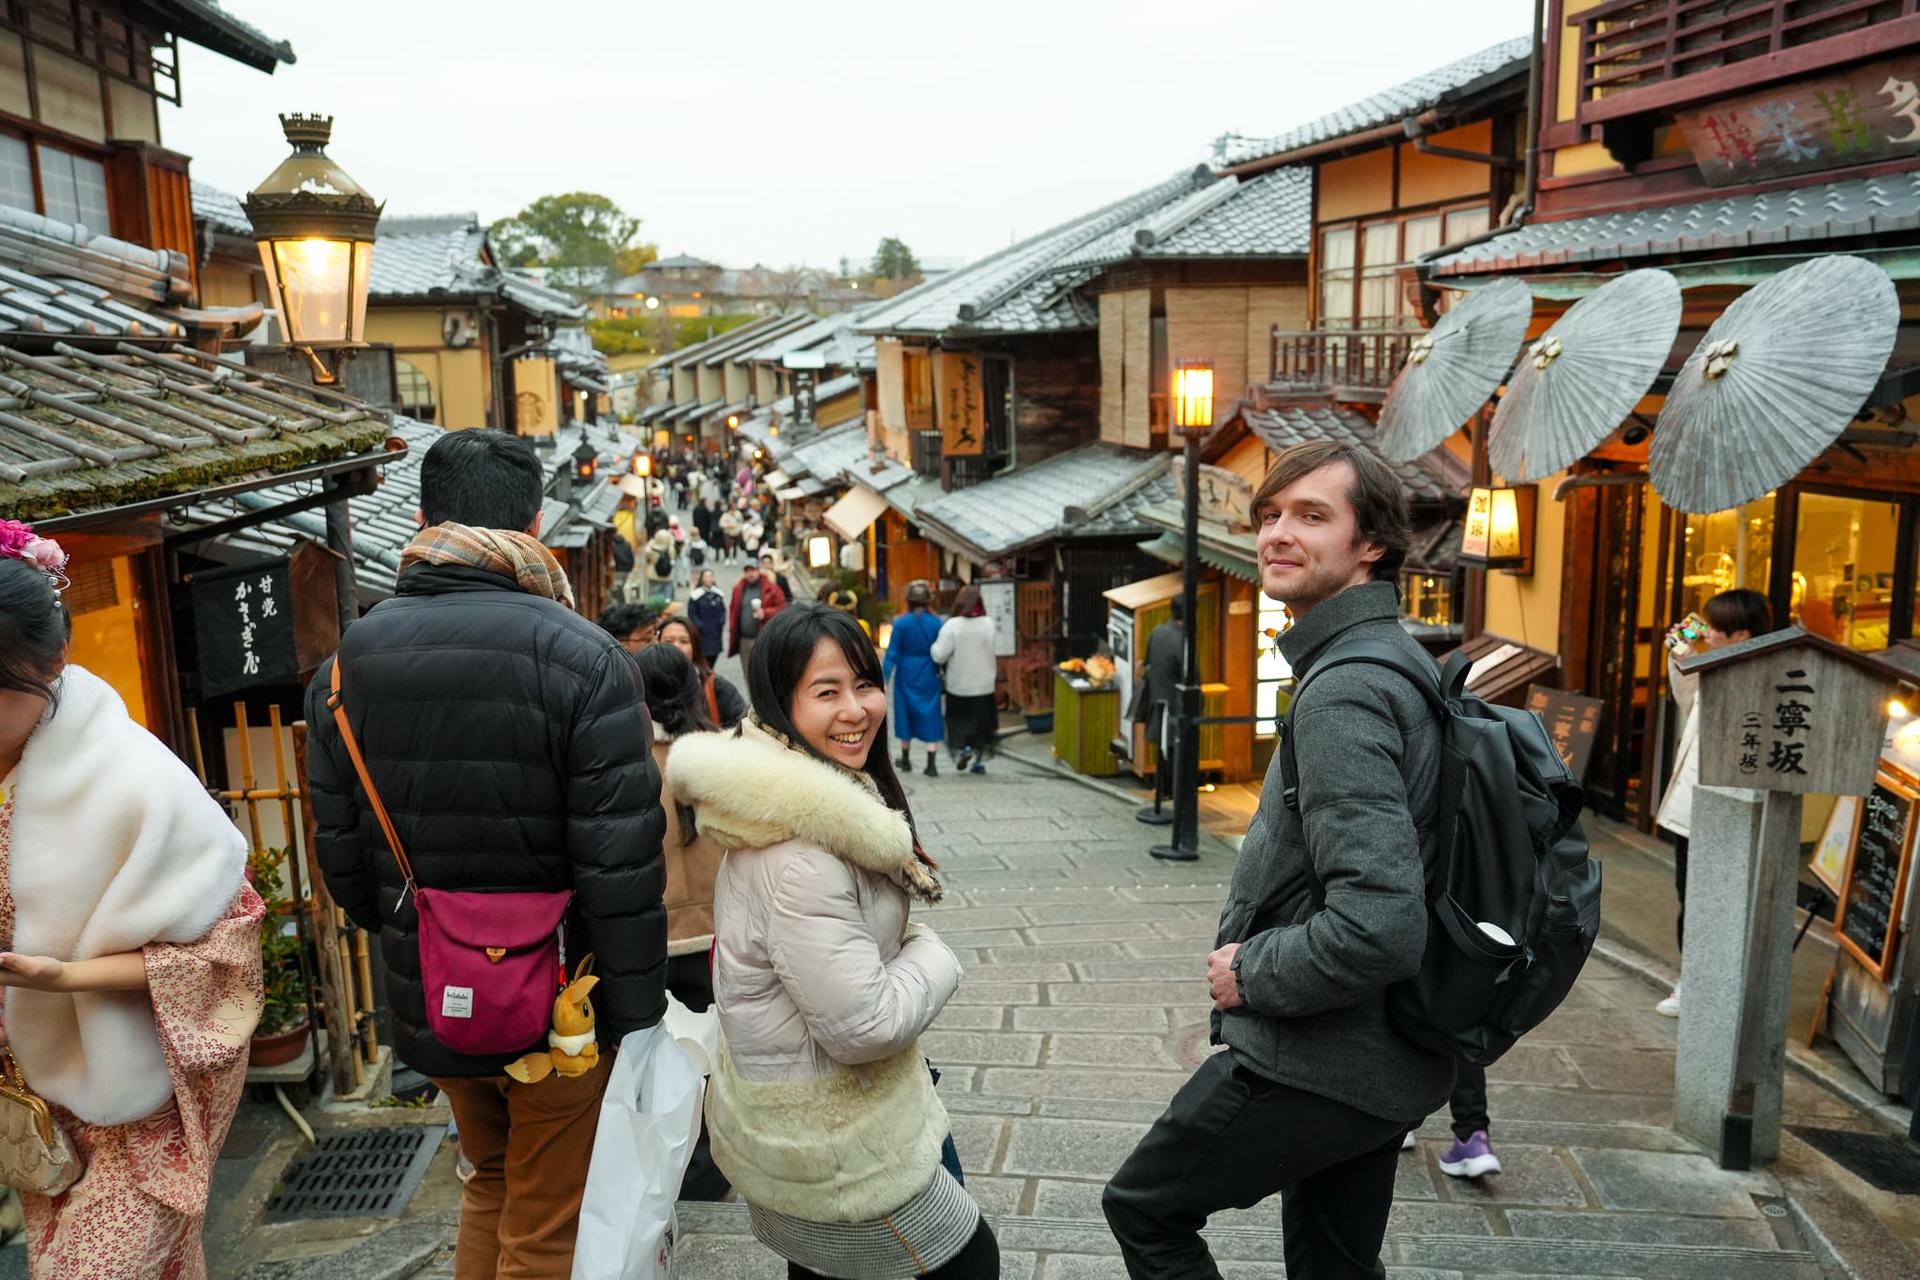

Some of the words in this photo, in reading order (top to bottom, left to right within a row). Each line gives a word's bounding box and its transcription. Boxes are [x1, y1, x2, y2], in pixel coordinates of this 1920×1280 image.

[259, 574, 278, 618] 甘党
[1766, 669, 1815, 775] 二寧坂
